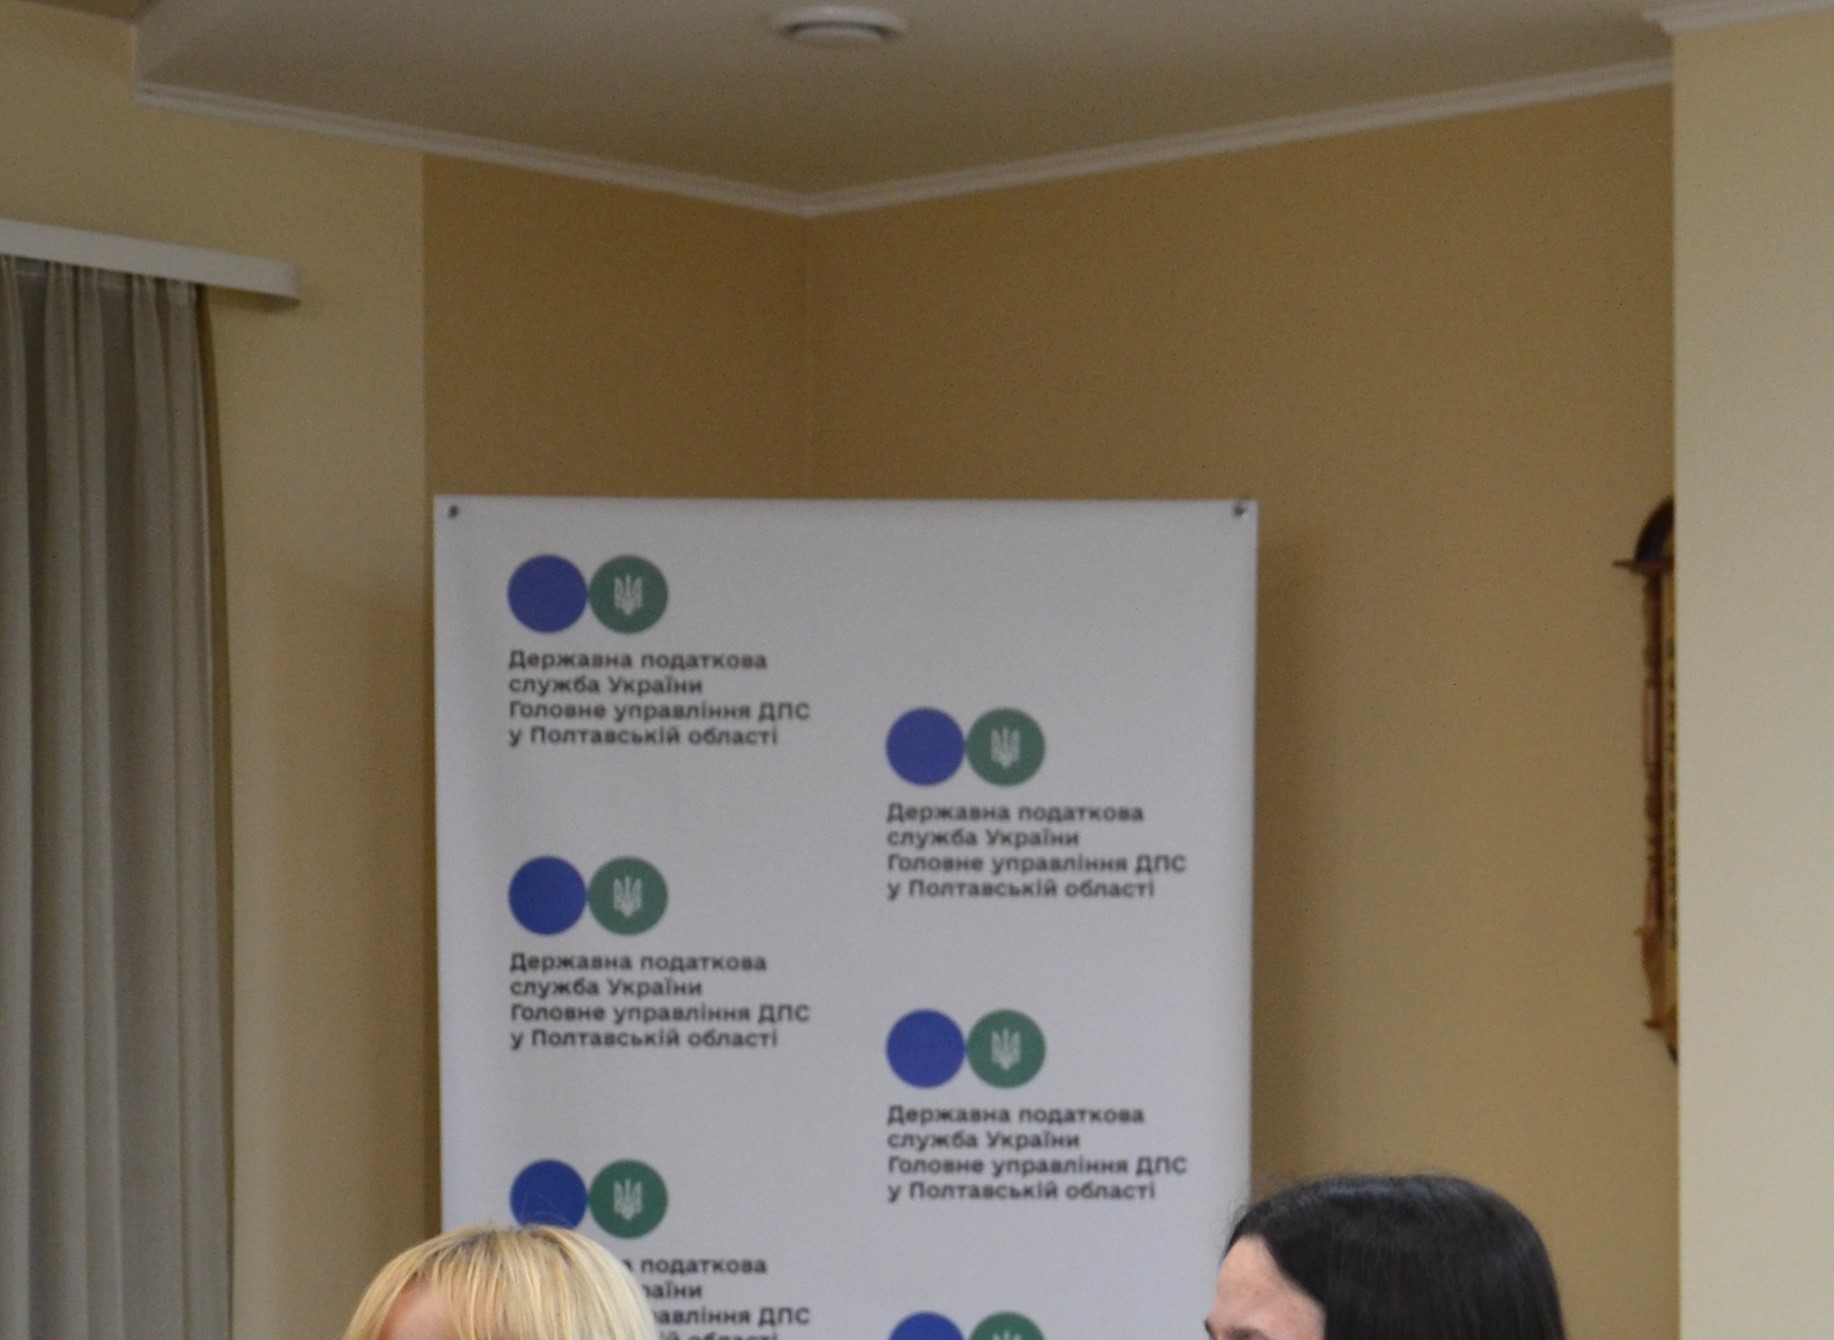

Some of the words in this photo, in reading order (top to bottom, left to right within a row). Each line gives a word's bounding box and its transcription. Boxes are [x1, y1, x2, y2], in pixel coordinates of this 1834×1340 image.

[508, 650, 632, 672] Державна
[641, 654, 767, 672] податкова
[509, 674, 600, 696] служба
[608, 674, 702, 696] України
[509, 701, 606, 719] Головне
[614, 701, 751, 723] управління
[758, 702, 810, 722] ДПС
[509, 729, 522, 748] у
[530, 725, 680, 745] Полтавській
[688, 725, 778, 745] області
[886, 802, 1010, 824] Державна
[1018, 806, 1144, 824] податкова
[887, 826, 978, 848] служба
[986, 826, 1079, 848] України
[888, 853, 984, 872] Головне
[991, 853, 1128, 876] управління
[1135, 854, 1186, 874] ДПС
[888, 881, 900, 900] у
[909, 877, 1057, 898] Полтавській
[1064, 877, 1154, 898] області
[509, 952, 632, 974] Державна
[640, 956, 767, 974] податкова
[510, 976, 599, 998] служба
[607, 976, 702, 998] України
[511, 1003, 606, 1021] Головне
[613, 1003, 751, 1025] управління
[758, 1004, 809, 1024] ДПС
[511, 1031, 524, 1050] у
[531, 1027, 680, 1047] Полтавській
[687, 1027, 777, 1047] області
[887, 1104, 1011, 1126] Державна
[1019, 1108, 1144, 1126] податкова
[887, 1128, 978, 1150] служба
[986, 1128, 1080, 1150] України
[888, 1155, 985, 1174] Головне
[992, 1155, 1128, 1178] управління
[1135, 1156, 1186, 1176] ДПС
[888, 1183, 901, 1202] у
[909, 1179, 1058, 1200] Полтавській
[1065, 1179, 1155, 1200] області
[641, 1259, 768, 1277] податкова
[641, 1278, 703, 1300] аїни
[653, 1306, 752, 1325] авління
[758, 1307, 811, 1327] ДПС
